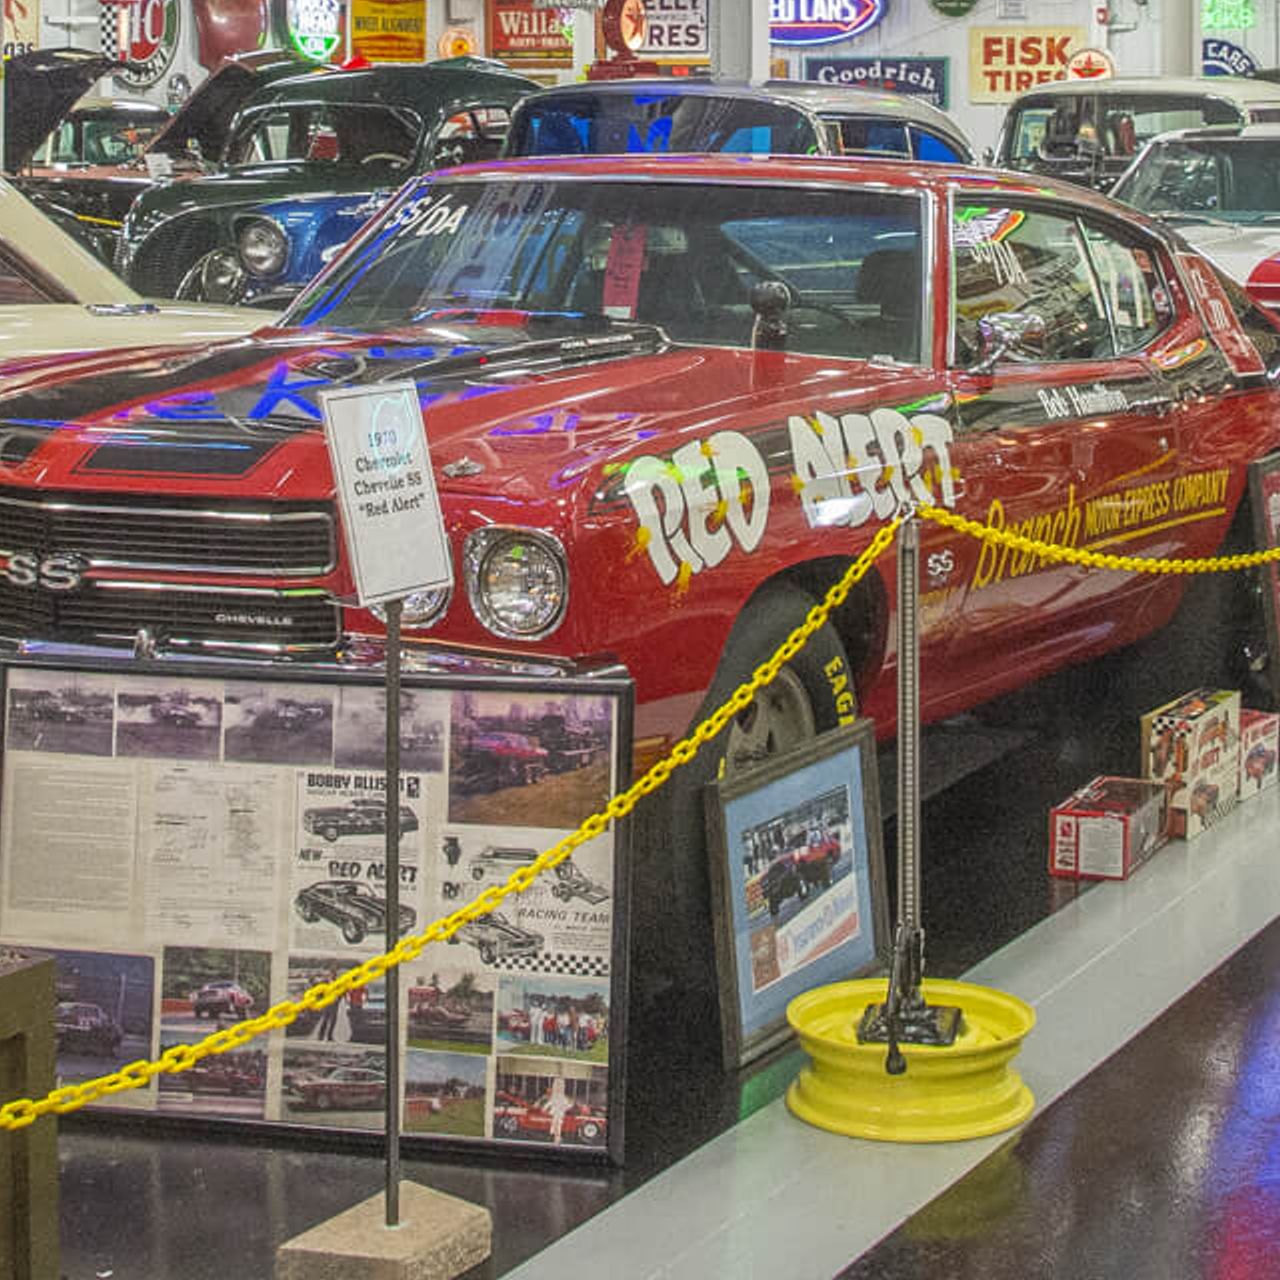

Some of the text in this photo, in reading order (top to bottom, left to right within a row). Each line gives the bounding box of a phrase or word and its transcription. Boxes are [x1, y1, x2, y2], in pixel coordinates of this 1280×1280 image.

[648, 24, 701, 47] RES
[983, 36, 1072, 65] FISK
[818, 61, 936, 90] Goodrich
[385, 194, 468, 238] SS/DA
[368, 430, 397, 448] 1970
[356, 452, 413, 472] Chevrolet
[354, 472, 422, 496] Chevelle SS
[624, 408, 957, 585] RED ALERT
[1085, 470, 1230, 537] MOTOR EXPRESS COMPANY
[7, 552, 81, 590] SS
[215, 613, 292, 626] CHEVELLE
[307, 773, 407, 792] BOBBY ALLISN
[328, 861, 418, 882] RED ALRT
[519, 908, 609, 924] RACING TEAM
